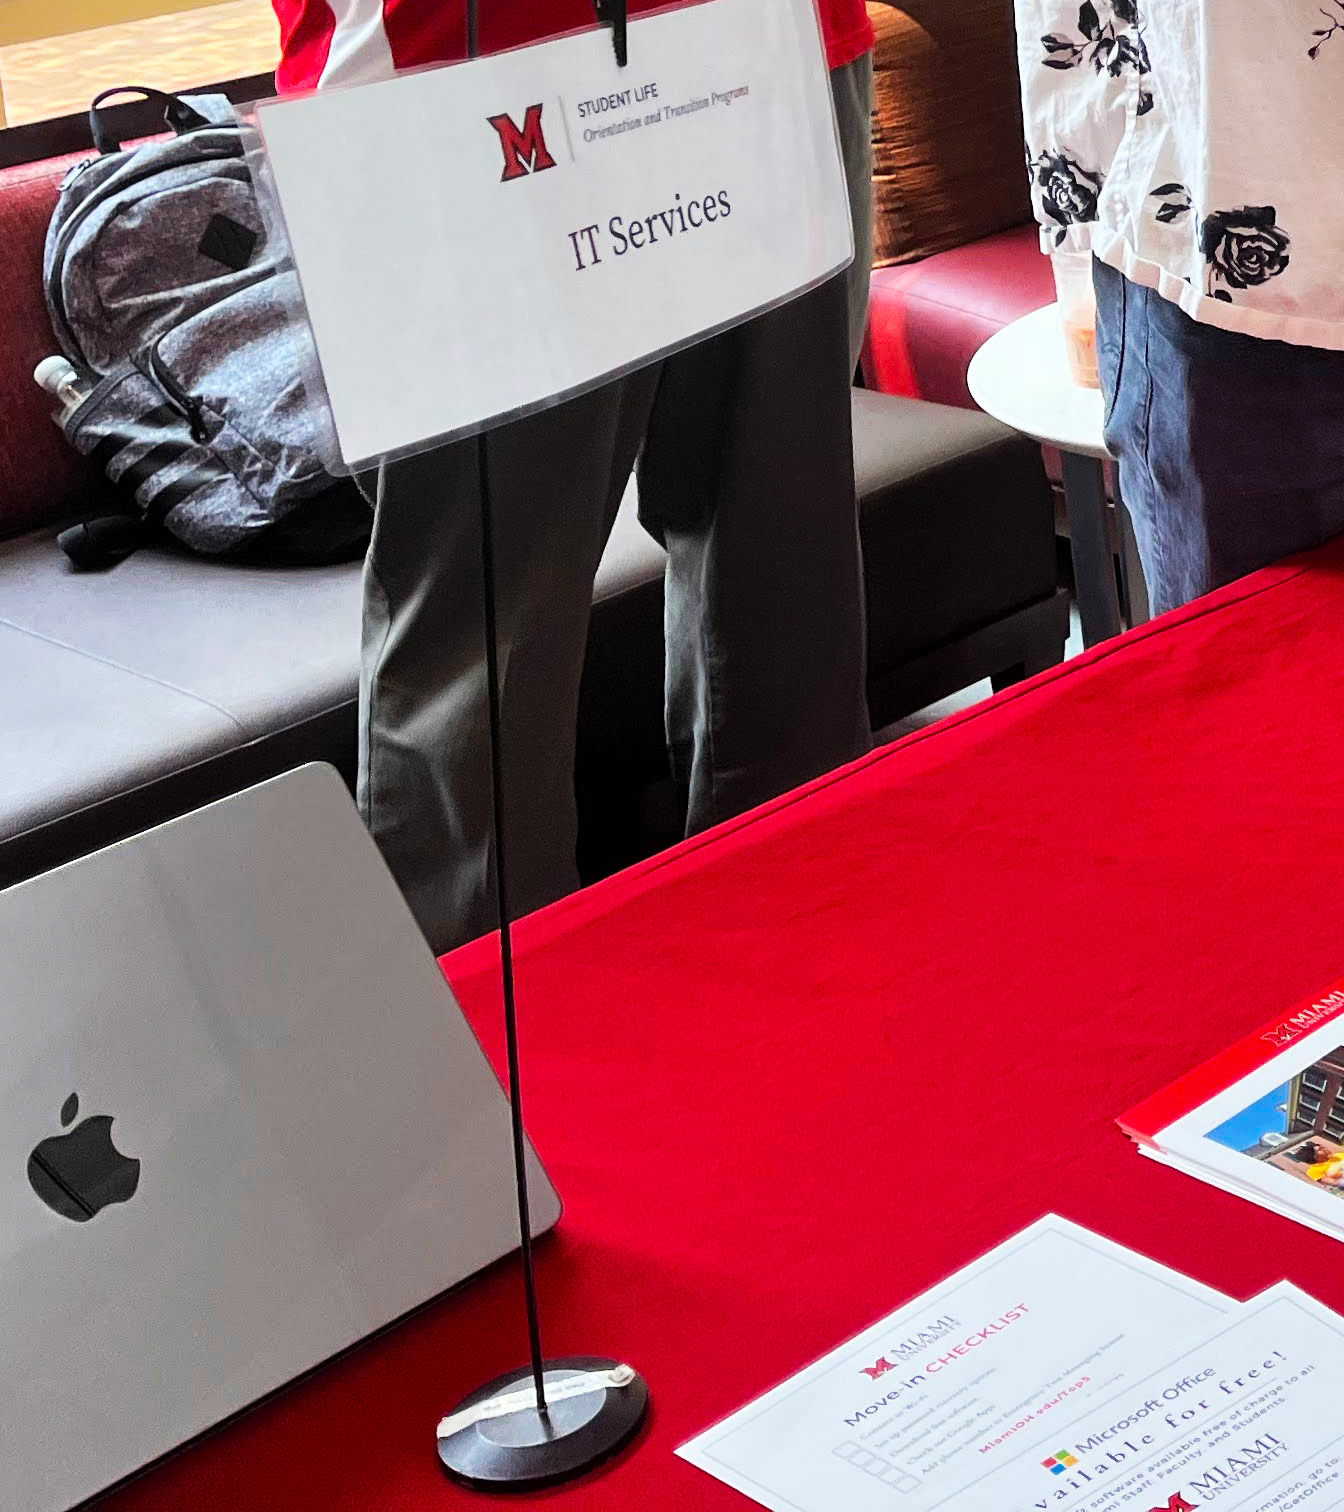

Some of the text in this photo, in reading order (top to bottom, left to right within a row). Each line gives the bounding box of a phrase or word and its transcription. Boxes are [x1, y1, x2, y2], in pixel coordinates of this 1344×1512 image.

[578, 83, 659, 117] STUDENT LIFE
[583, 116, 642, 143] Orientation
[643, 110, 661, 126] and
[664, 97, 710, 120] Transition
[568, 190, 732, 271] IT Services
[843, 1302, 1031, 1427] Move-in CHECKLIST
[890, 1314, 957, 1359] MIAMI
[1033, 1349, 1288, 1511] vailable for free!
[1075, 1399, 1165, 1456] Microsoft
[1162, 1365, 1217, 1401] Office
[1089, 1468, 1145, 1509] software
[1146, 1435, 1202, 1474] available
[1201, 1421, 1229, 1439] free
[1228, 1412, 1244, 1424] of
[1242, 1386, 1285, 1416] charge
[1282, 1374, 1299, 1387] to
[1299, 1363, 1316, 1377] all
[1205, 1429, 1233, 1449] and
[1188, 1431, 1282, 1497] MIAMI
[1202, 1441, 1289, 1502] UNIVERSITY
[1307, 1465, 1326, 1483] go
